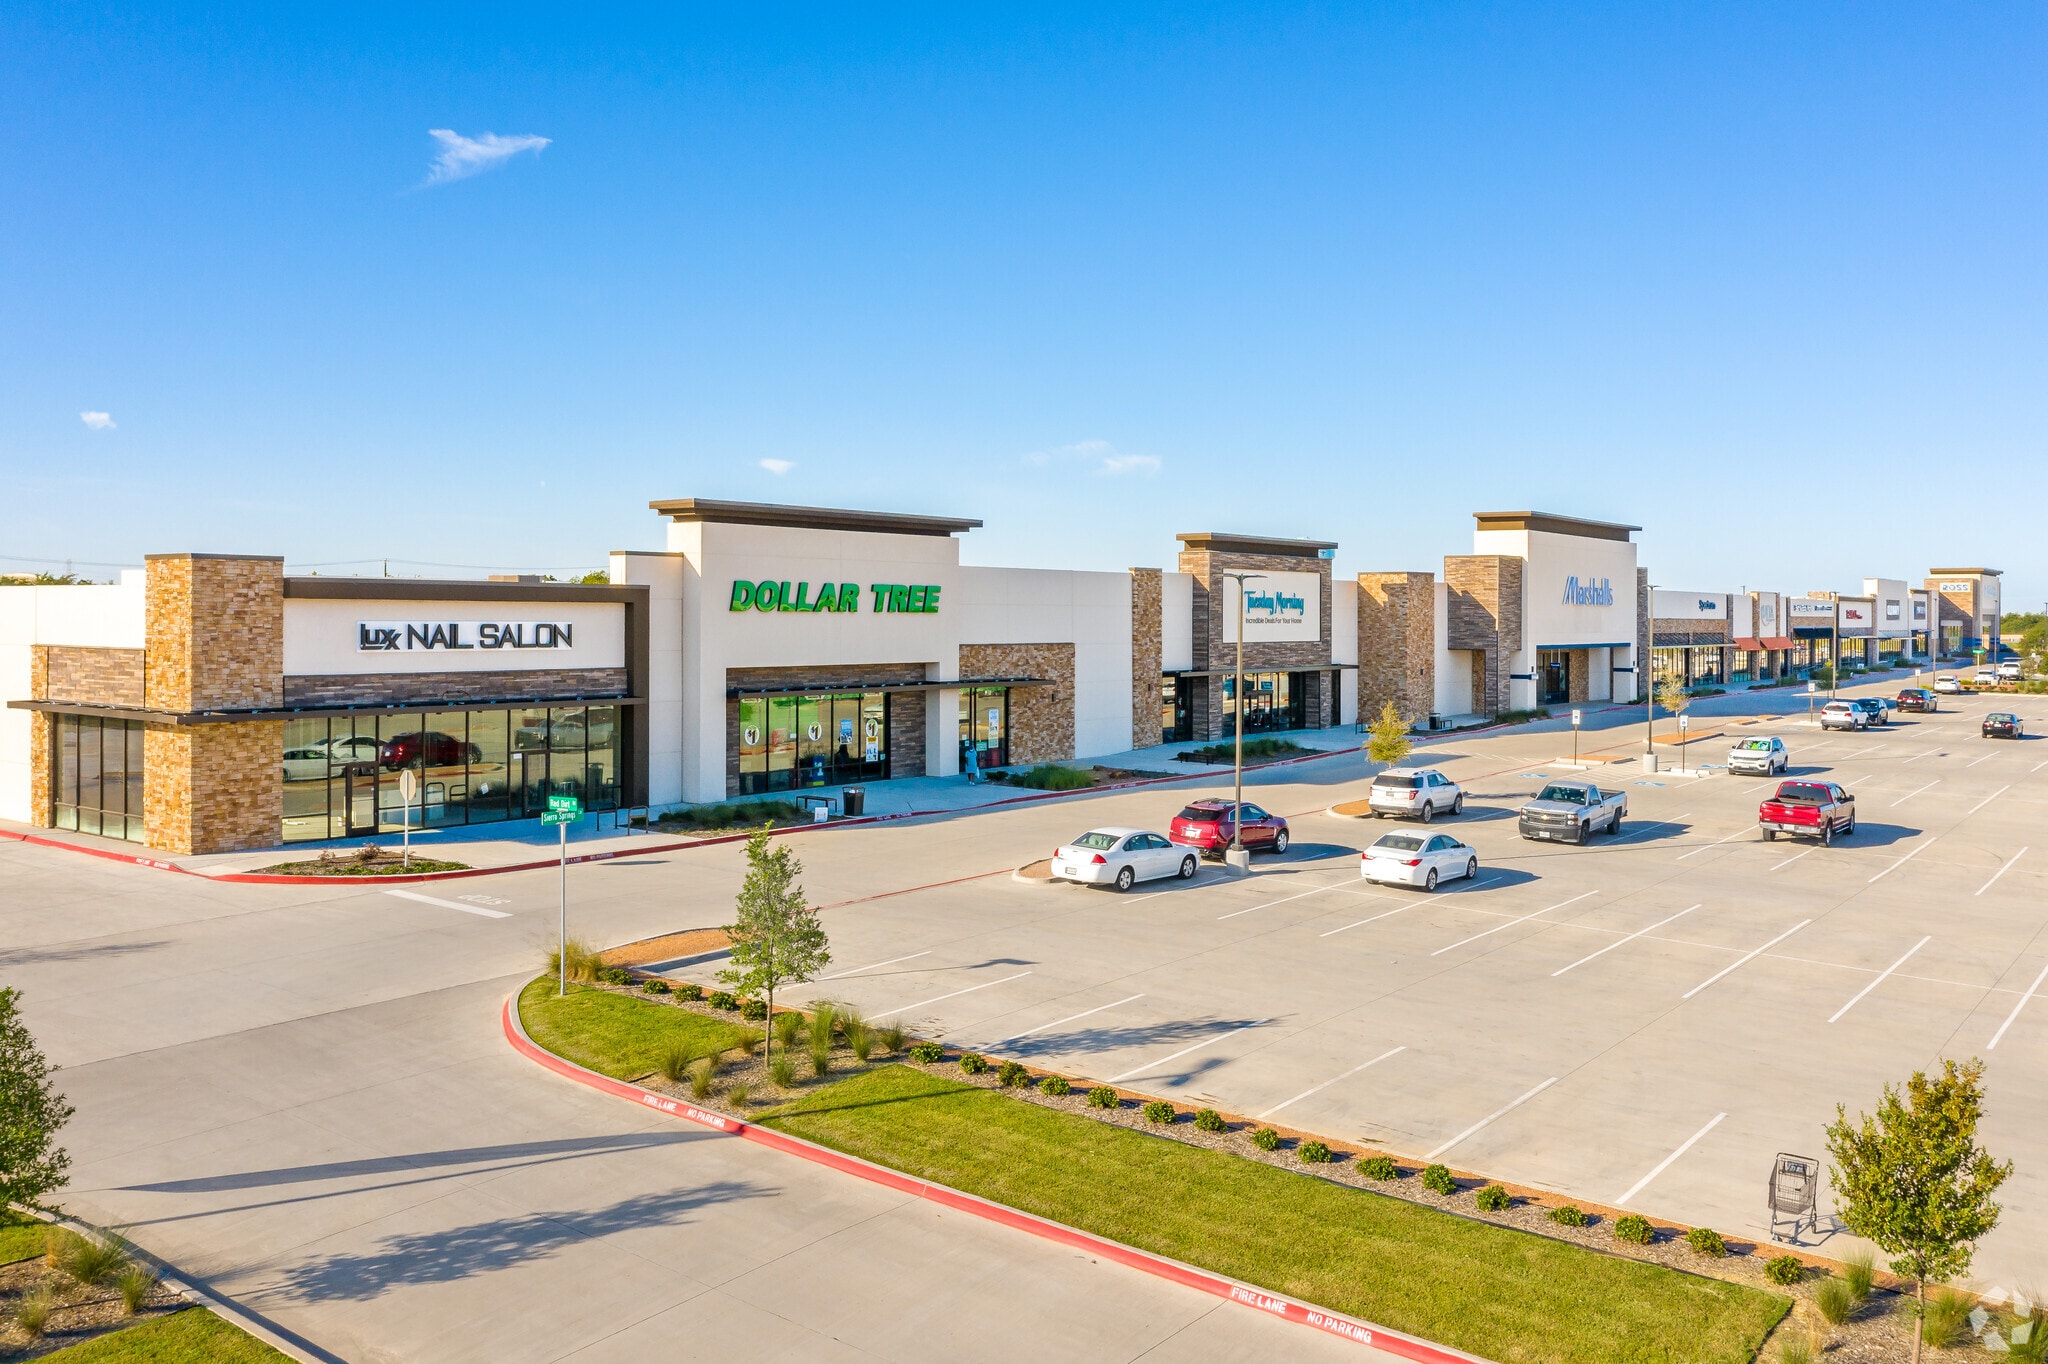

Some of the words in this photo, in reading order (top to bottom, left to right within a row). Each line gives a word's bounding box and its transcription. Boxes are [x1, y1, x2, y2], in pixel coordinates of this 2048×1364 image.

[729, 580, 860, 613] DOLLAR
[871, 584, 942, 613] TREE
[1244, 590, 1274, 615] Tuesday
[1274, 591, 1305, 616] Morning
[1562, 575, 1613, 606] Marshalls
[407, 623, 474, 650] NAIL
[479, 623, 573, 649] SALON
[558, 811, 576, 822] Springs
[643, 1094, 658, 1107] FIRE
[658, 1099, 677, 1112] LANE
[686, 1108, 697, 1118] NO
[697, 1111, 726, 1128] PARKING
[1231, 1286, 1256, 1304] FIRE
[1257, 1295, 1287, 1314] LANE
[1307, 1311, 1323, 1325] NO
[1324, 1317, 1372, 1343] PARKING
